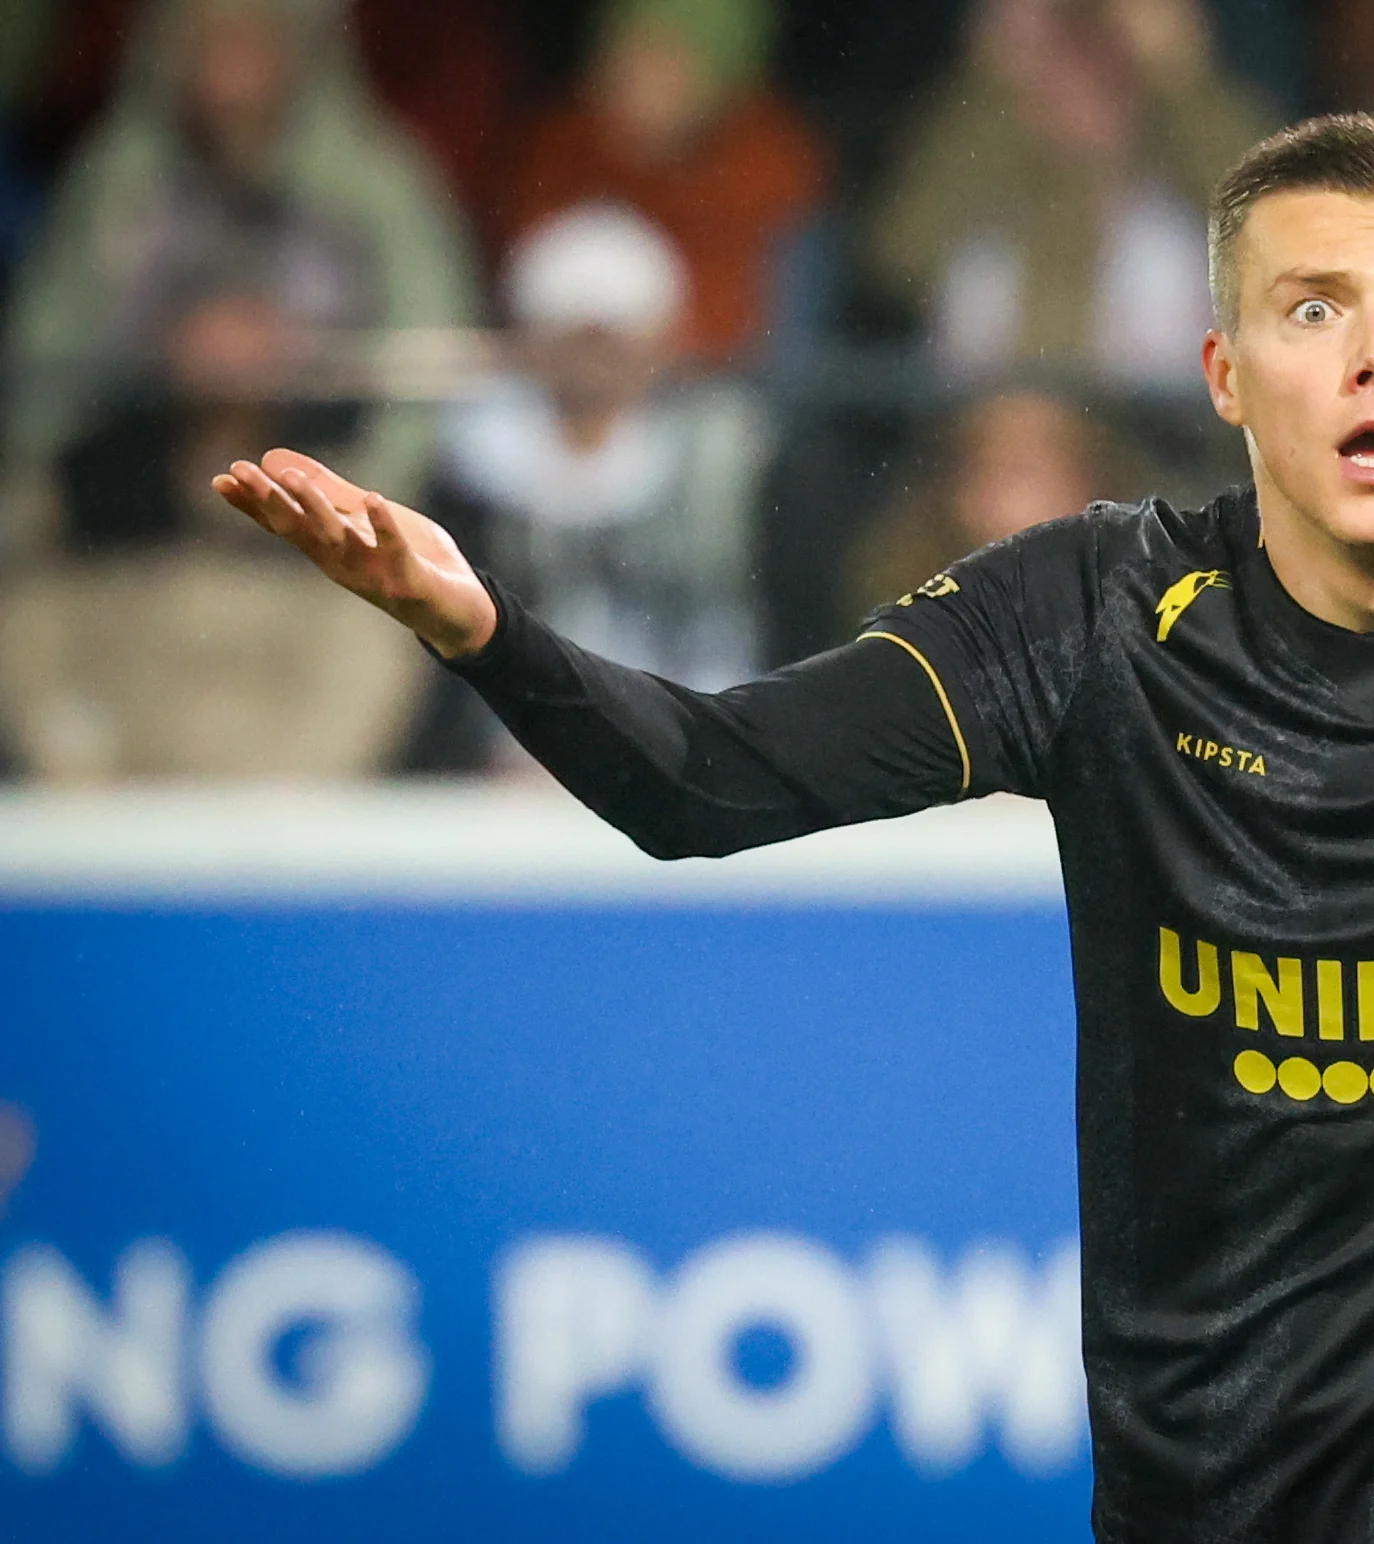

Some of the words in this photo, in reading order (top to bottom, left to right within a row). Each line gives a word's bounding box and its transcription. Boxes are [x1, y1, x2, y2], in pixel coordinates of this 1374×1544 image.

[1176, 732, 1266, 776] KIPSTA
[4, 1231, 426, 1476] NG
[495, 1231, 1085, 1476] POW
